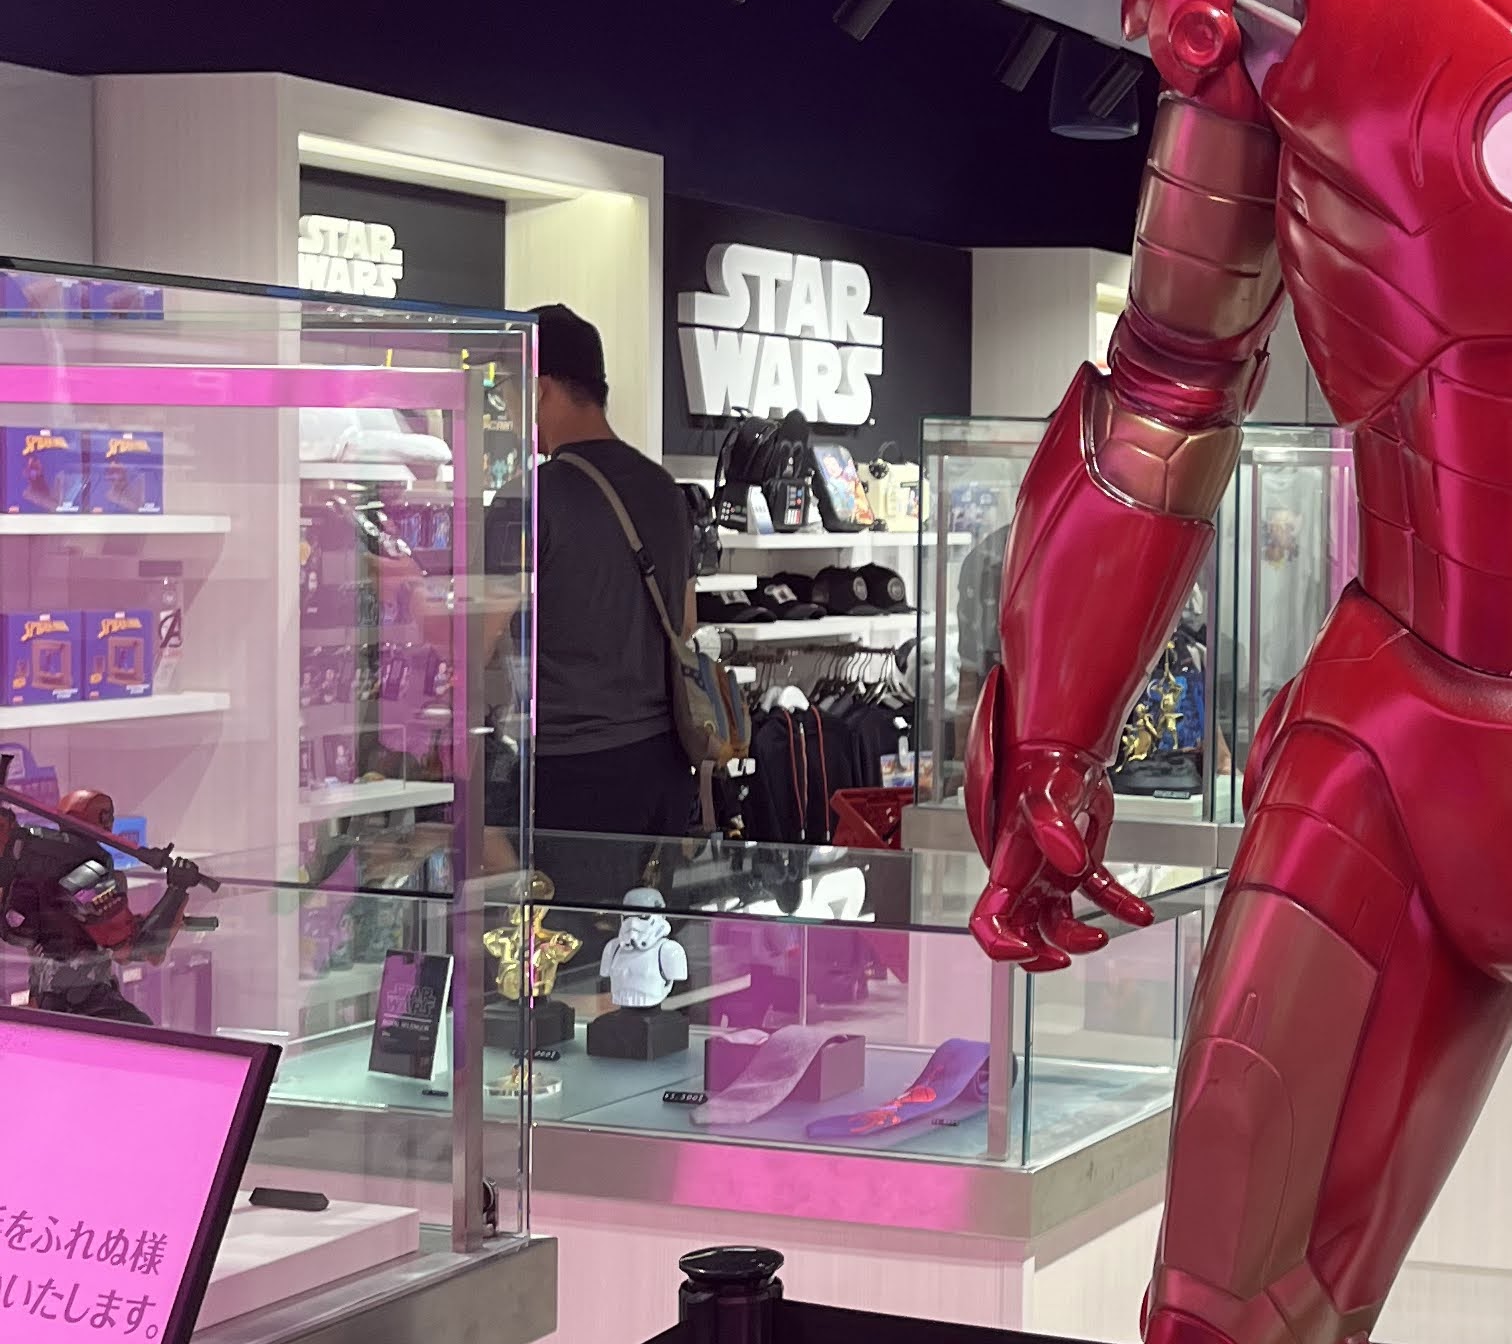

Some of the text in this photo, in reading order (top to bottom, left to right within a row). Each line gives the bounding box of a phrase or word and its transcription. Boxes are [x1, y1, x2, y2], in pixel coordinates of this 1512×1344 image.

[298, 215, 403, 264] STAR
[298, 253, 403, 299] WARS
[678, 243, 883, 346] STAR
[678, 327, 883, 425] WARS
[0, 1274, 158, 1339] いたします。
